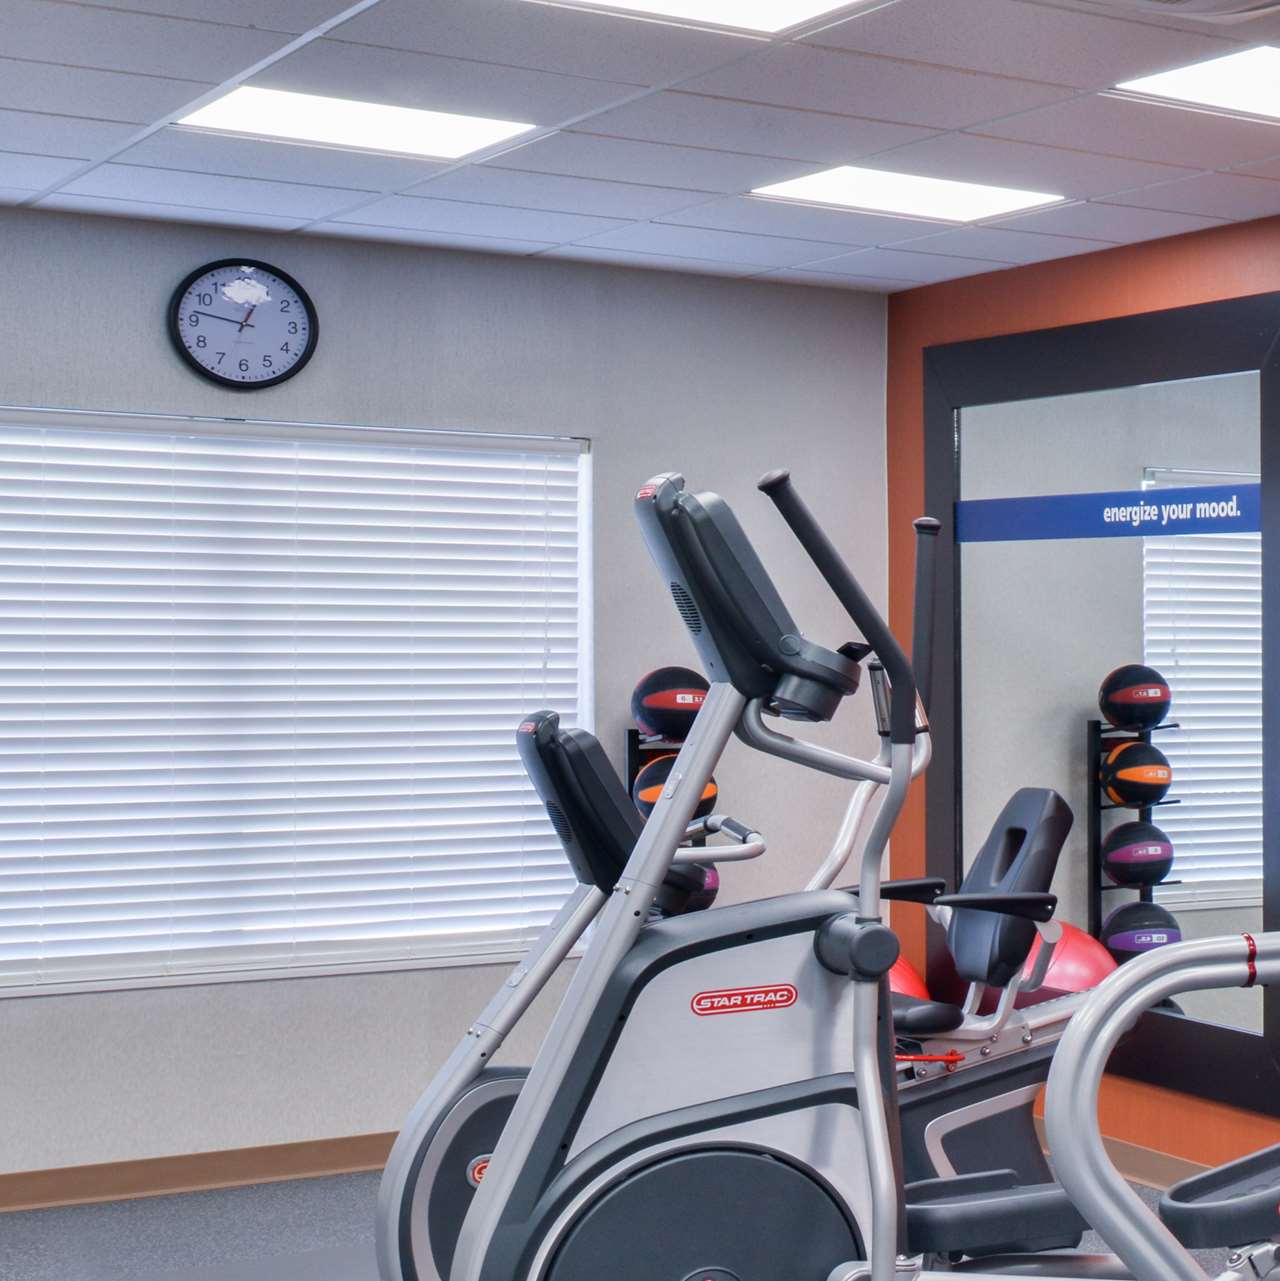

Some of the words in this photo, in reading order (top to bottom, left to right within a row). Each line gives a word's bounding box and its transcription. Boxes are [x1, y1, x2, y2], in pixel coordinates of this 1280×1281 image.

[196, 292, 213, 307] 10
[280, 299, 290, 313] 2
[188, 313, 199, 327] 9
[287, 321, 298, 335] 3
[196, 335, 207, 348] 8
[280, 341, 291, 354] 4
[215, 351, 226, 365] 7
[262, 355, 272, 368] 5
[238, 359, 249, 372] 6
[1103, 500, 1159, 527] energize
[1161, 503, 1193, 525] your
[1196, 495, 1241, 518] mood.
[699, 995, 742, 1009] STAR
[744, 991, 788, 1004] TRAC
